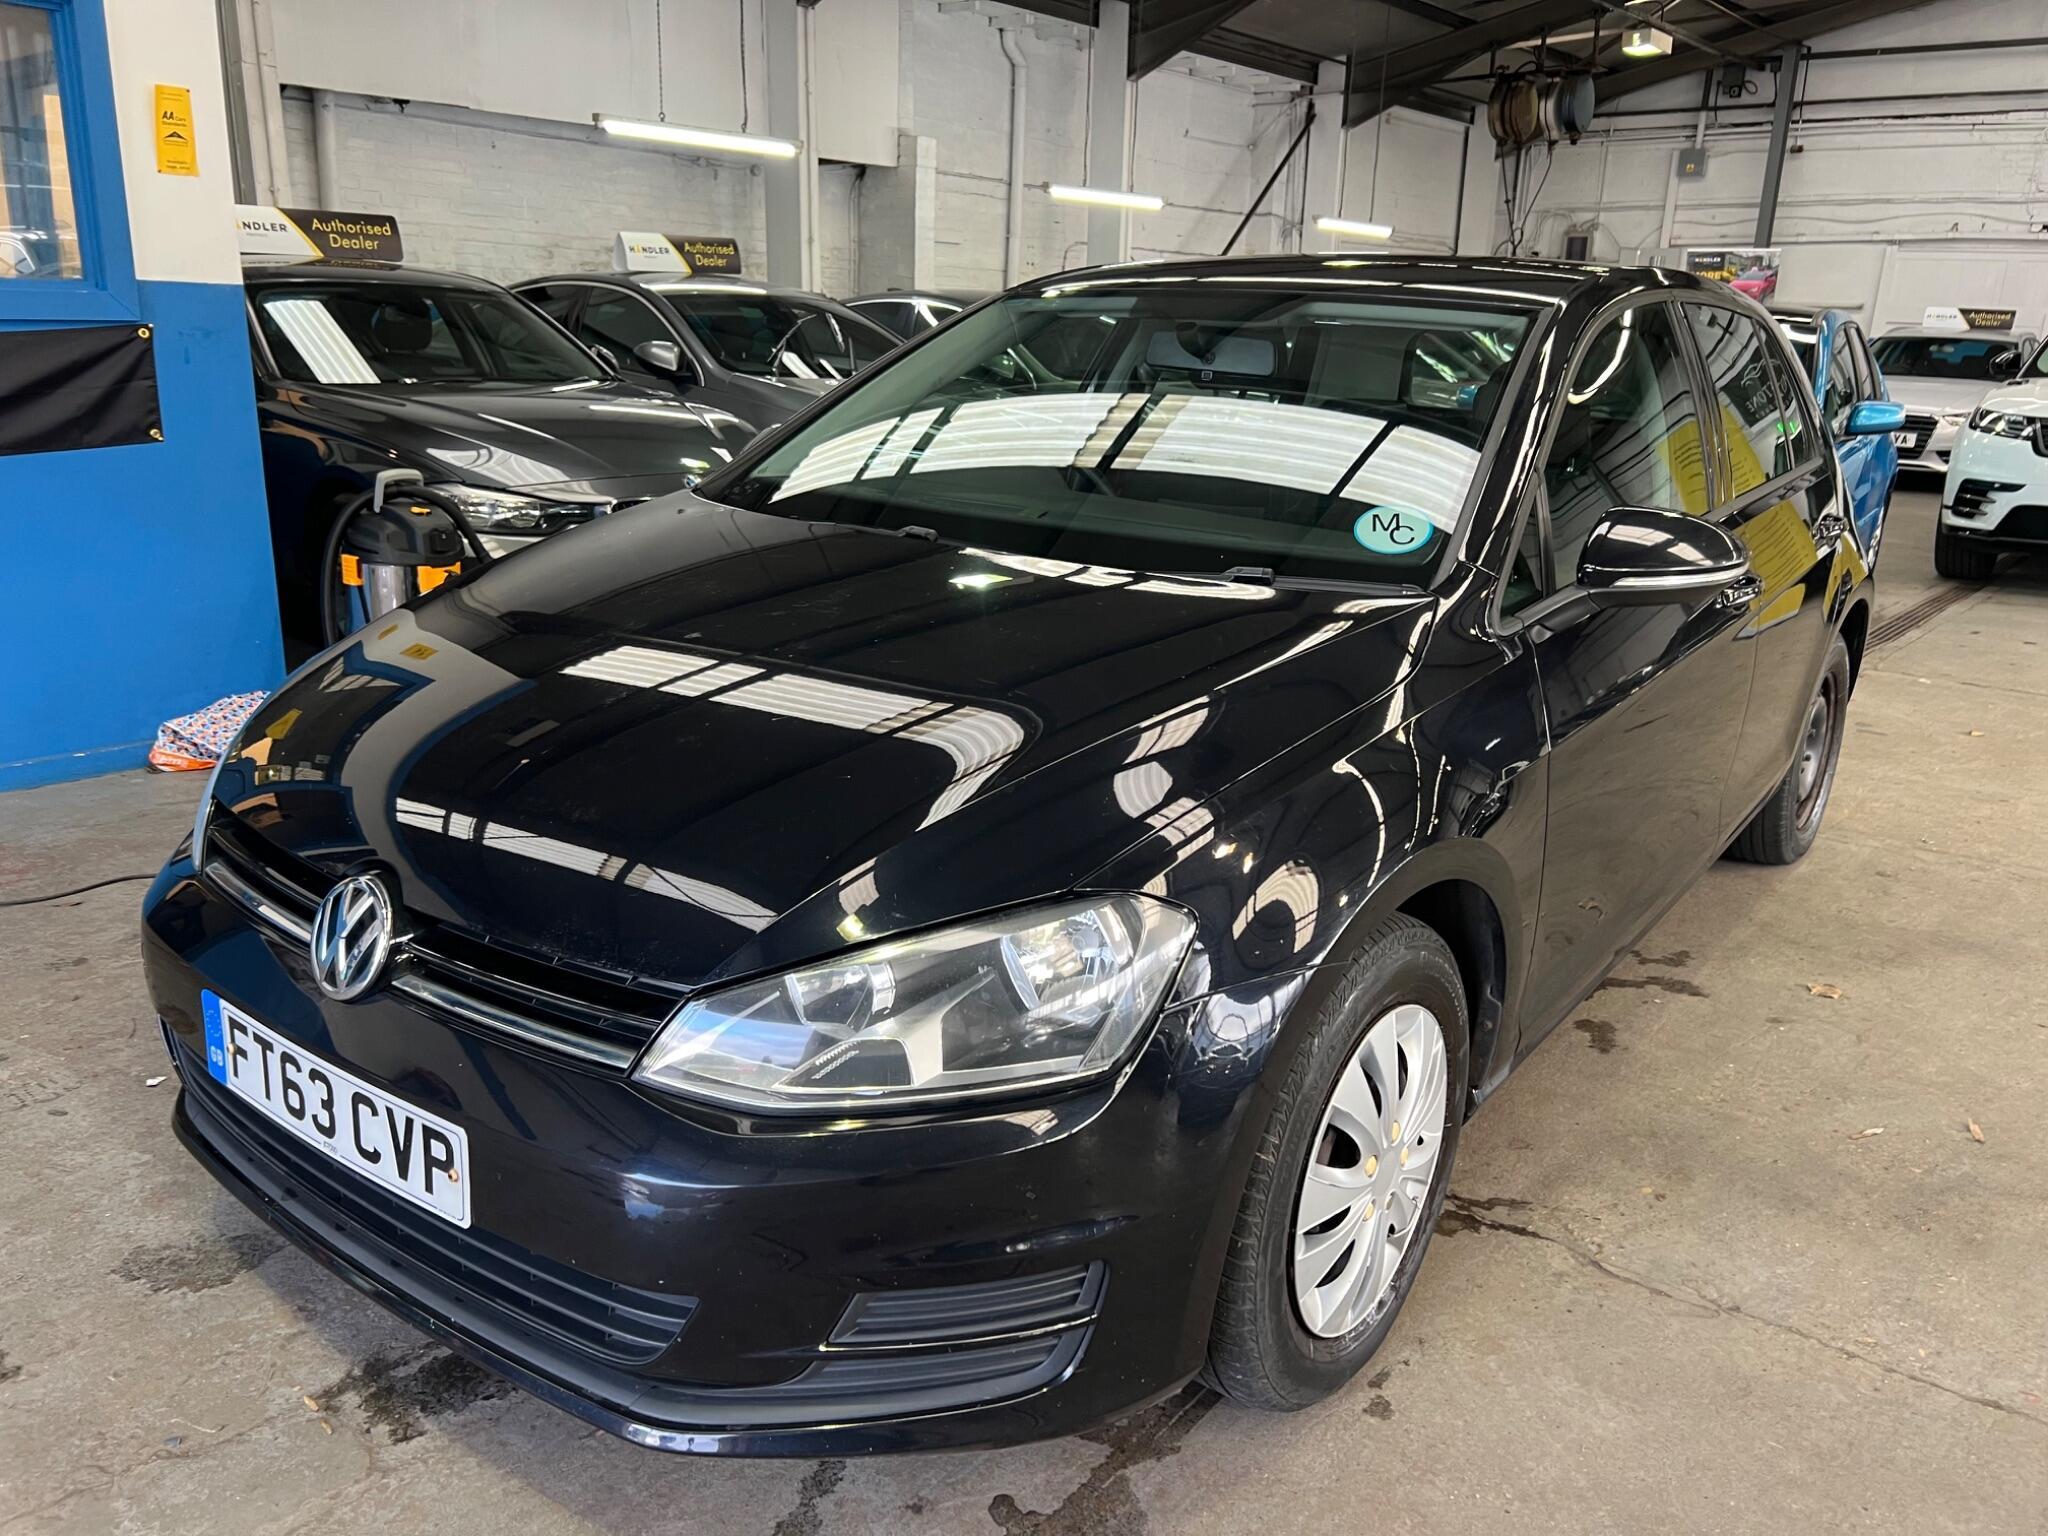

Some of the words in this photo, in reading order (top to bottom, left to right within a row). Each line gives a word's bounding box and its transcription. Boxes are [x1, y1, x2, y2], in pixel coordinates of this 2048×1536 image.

[162, 110, 175, 120] AA
[311, 218, 392, 236] Authorised
[329, 234, 380, 250] Dealer
[684, 242, 736, 256] Authorised
[695, 254, 728, 267] Dealer
[1969, 311, 2012, 321] Authorised
[1975, 319, 2001, 327] Dealer
[227, 1013, 336, 1140] FT63
[351, 1091, 455, 1196] CVP
